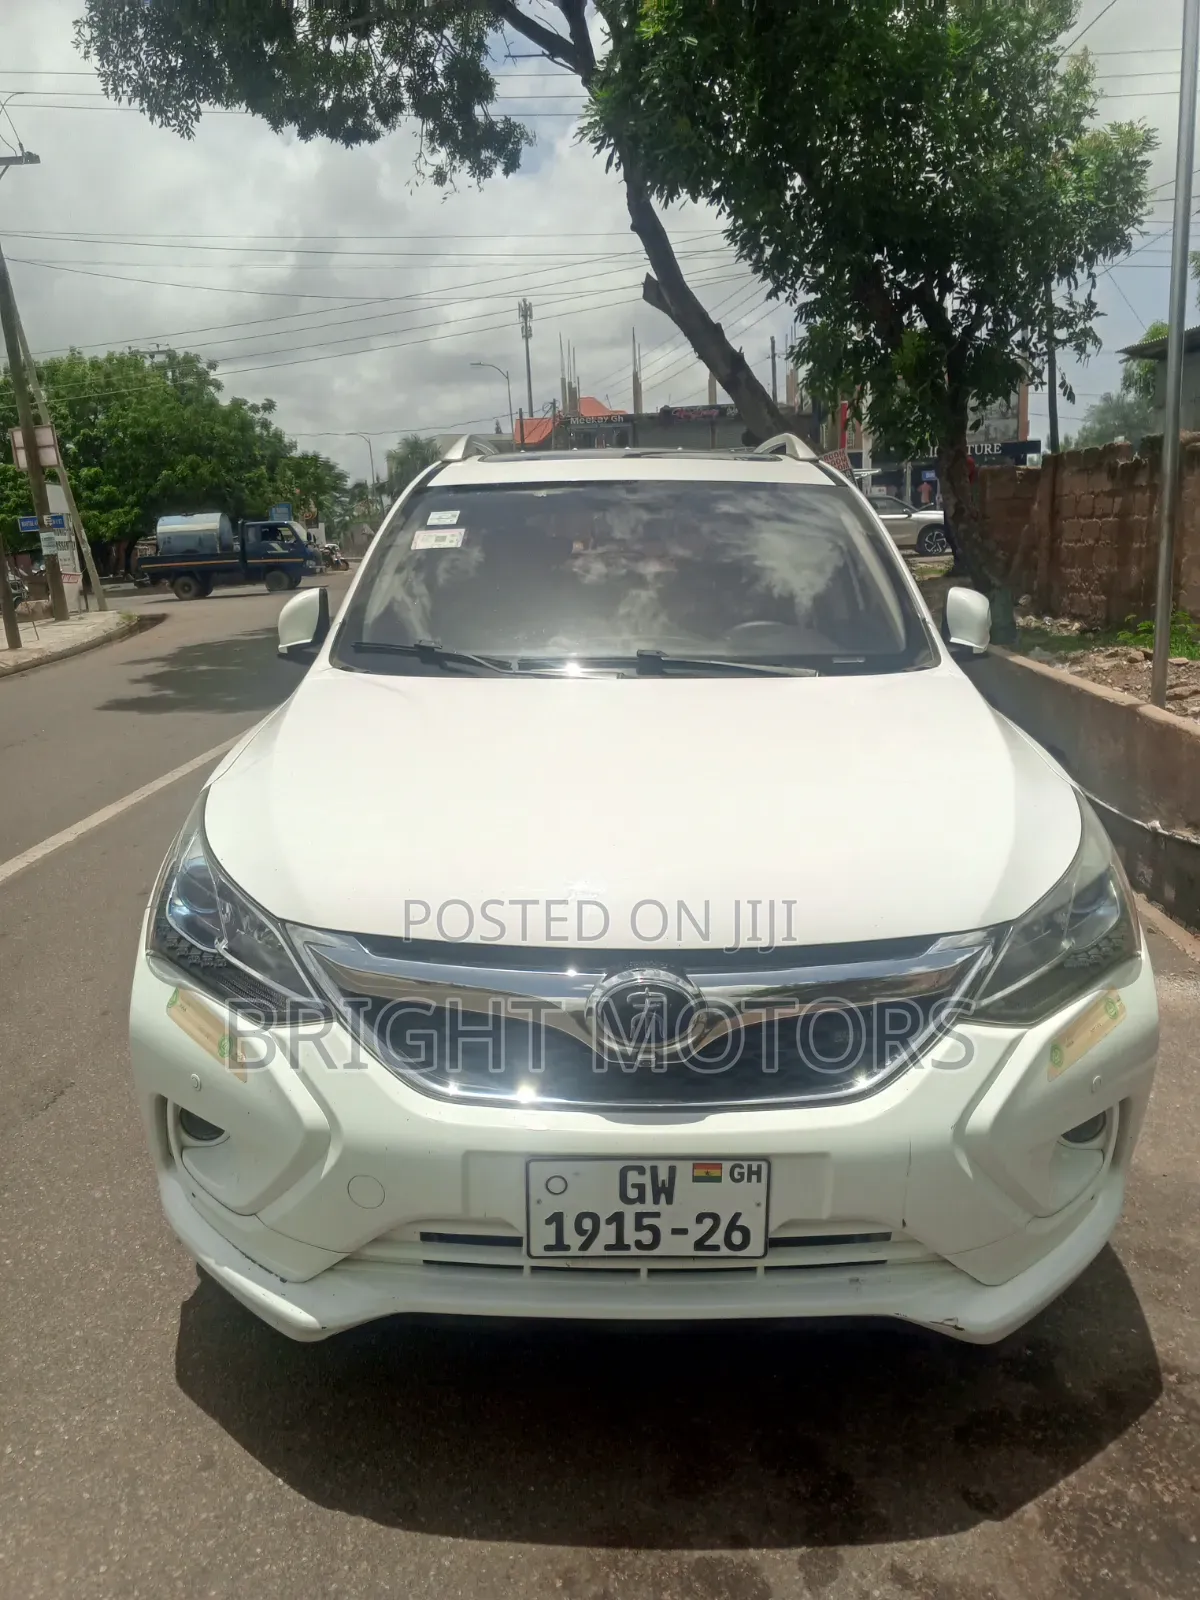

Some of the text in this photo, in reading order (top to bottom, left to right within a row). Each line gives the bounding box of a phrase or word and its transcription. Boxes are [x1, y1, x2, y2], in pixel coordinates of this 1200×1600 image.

[610, 415, 624, 423] Gh
[618, 1165, 677, 1206] GW
[729, 1163, 763, 1183] GH
[543, 1210, 751, 1252] 1915-26
